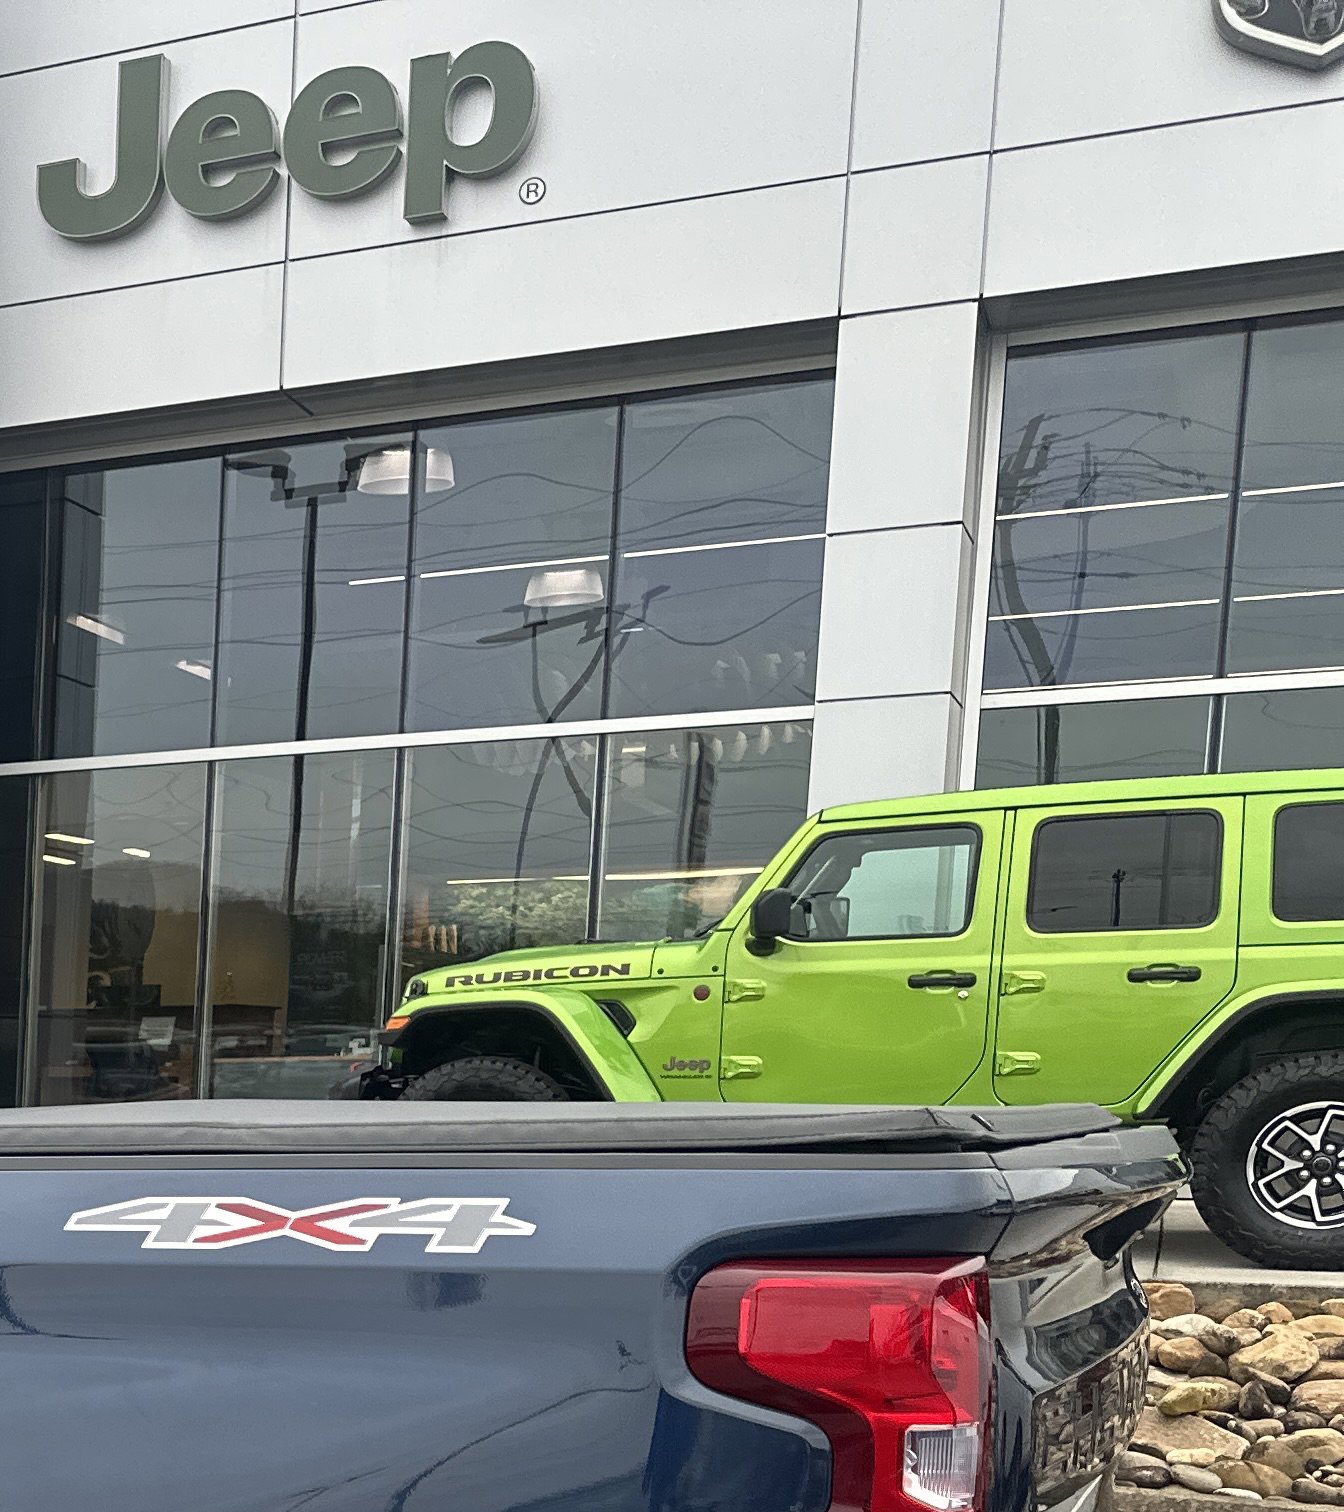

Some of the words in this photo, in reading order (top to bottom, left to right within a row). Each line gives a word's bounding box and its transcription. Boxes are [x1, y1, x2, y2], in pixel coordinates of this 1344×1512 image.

[36, 40, 539, 242] Jeep
[444, 962, 632, 988] RUBICON
[662, 1055, 711, 1073] Jeep
